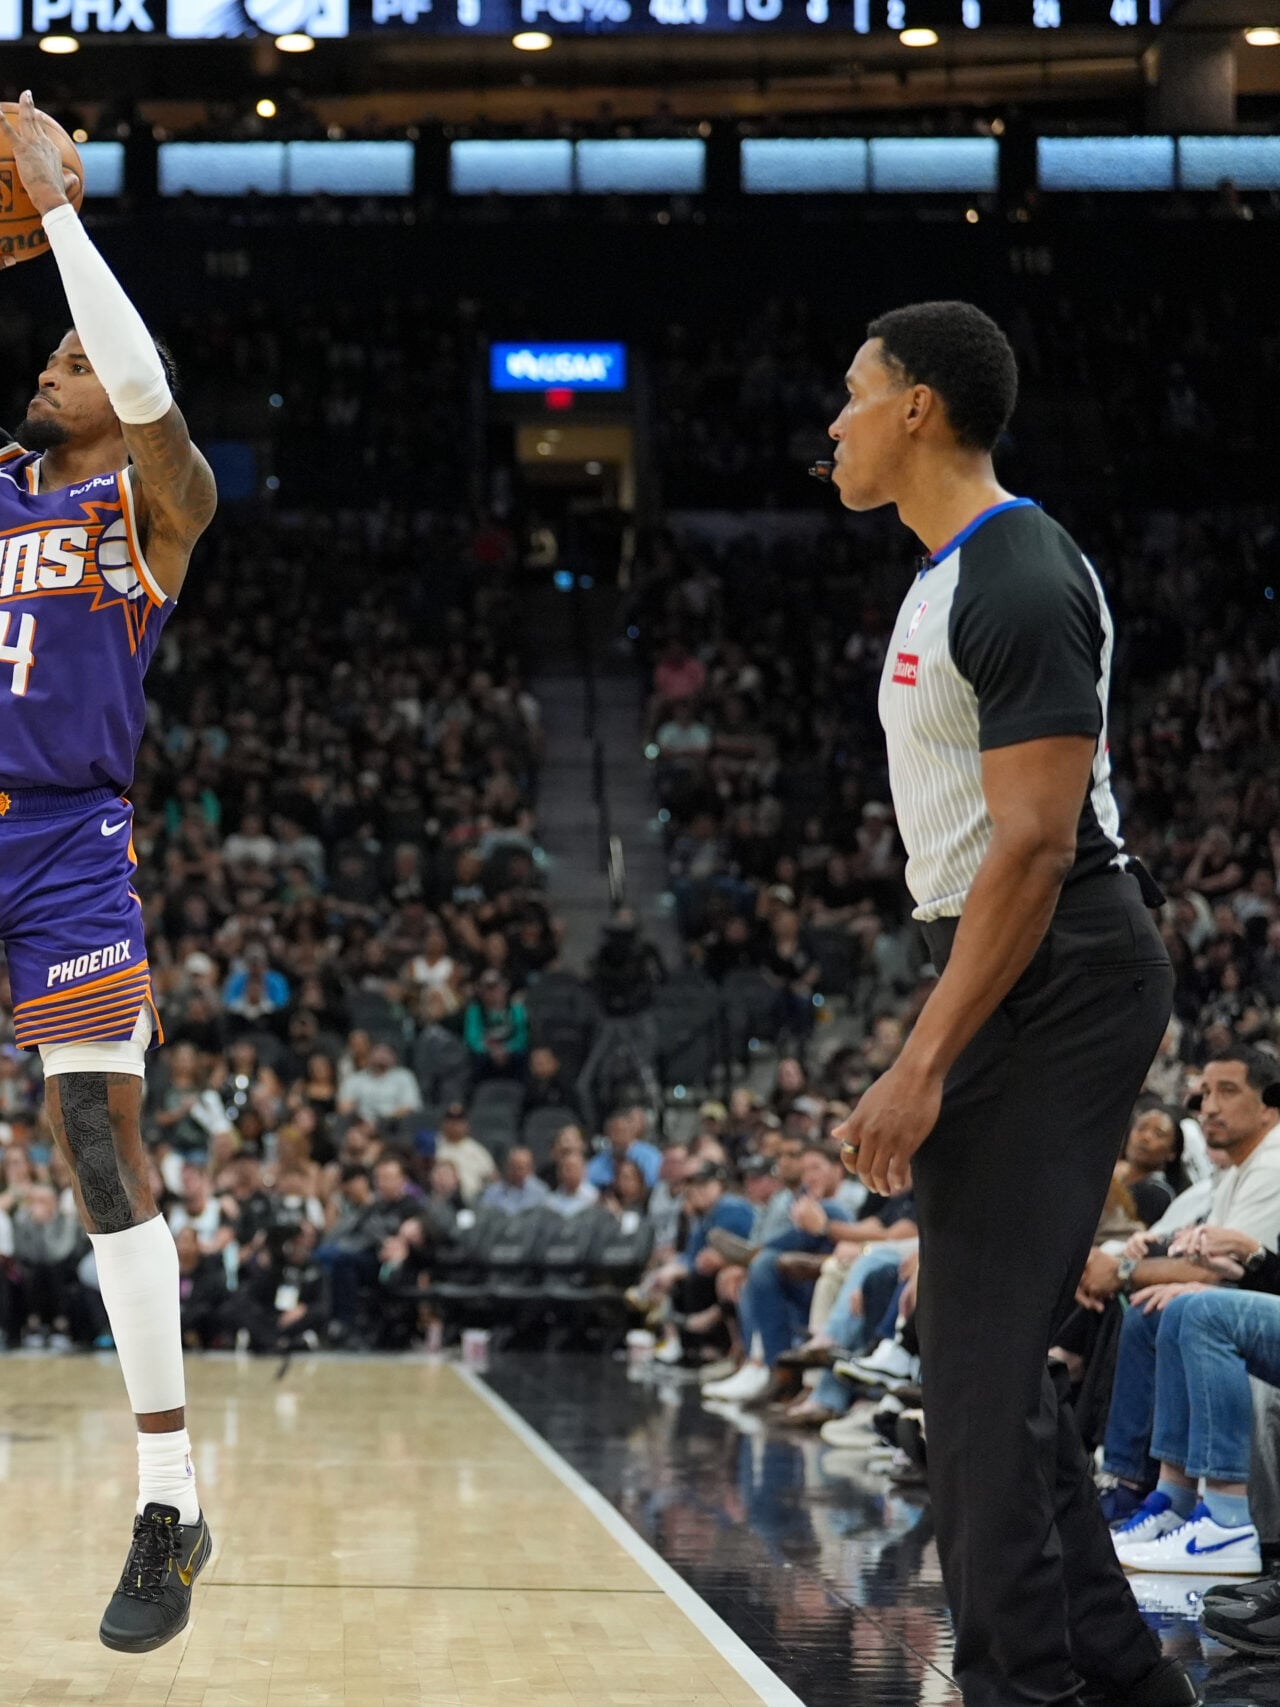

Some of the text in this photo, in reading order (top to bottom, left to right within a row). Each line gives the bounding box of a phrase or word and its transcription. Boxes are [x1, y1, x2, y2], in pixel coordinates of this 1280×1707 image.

[32, 0, 153, 32] PHX
[69, 474, 115, 497] PayPal
[47, 939, 131, 988] PHOENIX
